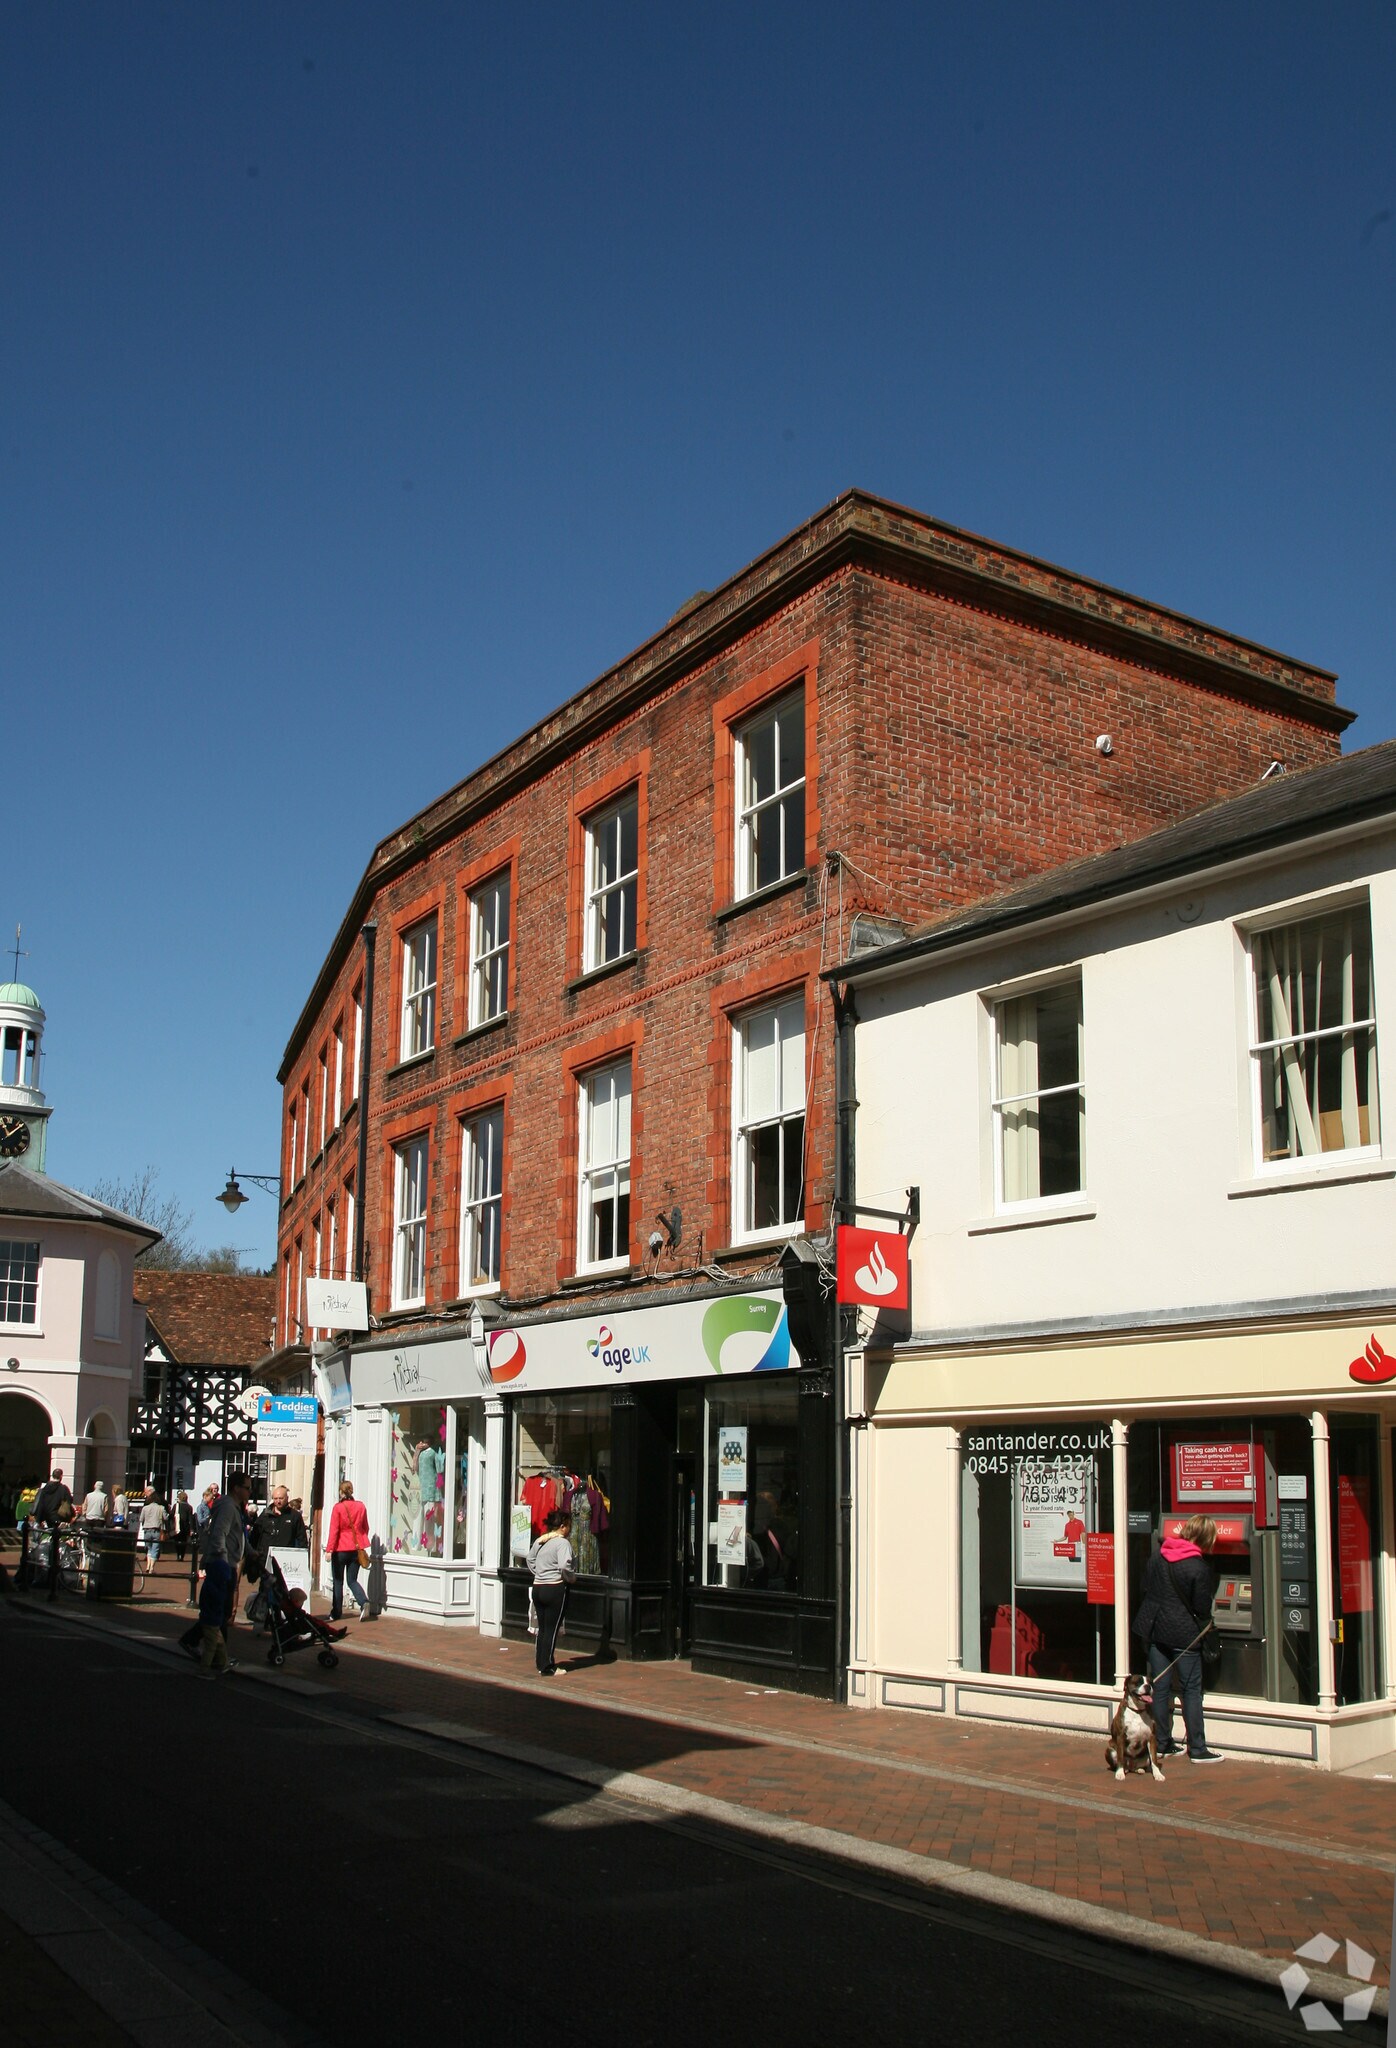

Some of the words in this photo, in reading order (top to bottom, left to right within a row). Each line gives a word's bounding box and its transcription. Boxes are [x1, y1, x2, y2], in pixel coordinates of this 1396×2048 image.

[749, 1305, 767, 1314] Surrey
[244, 1401, 258, 1410] HS
[275, 1401, 315, 1412] Teddies
[968, 1429, 1111, 1451] santander.co.uk
[968, 1456, 1009, 1475] 0845
[1014, 1455, 1046, 1474] 765
[1052, 1454, 1094, 1474] 4321
[1025, 1473, 1059, 1485] 3.00%
